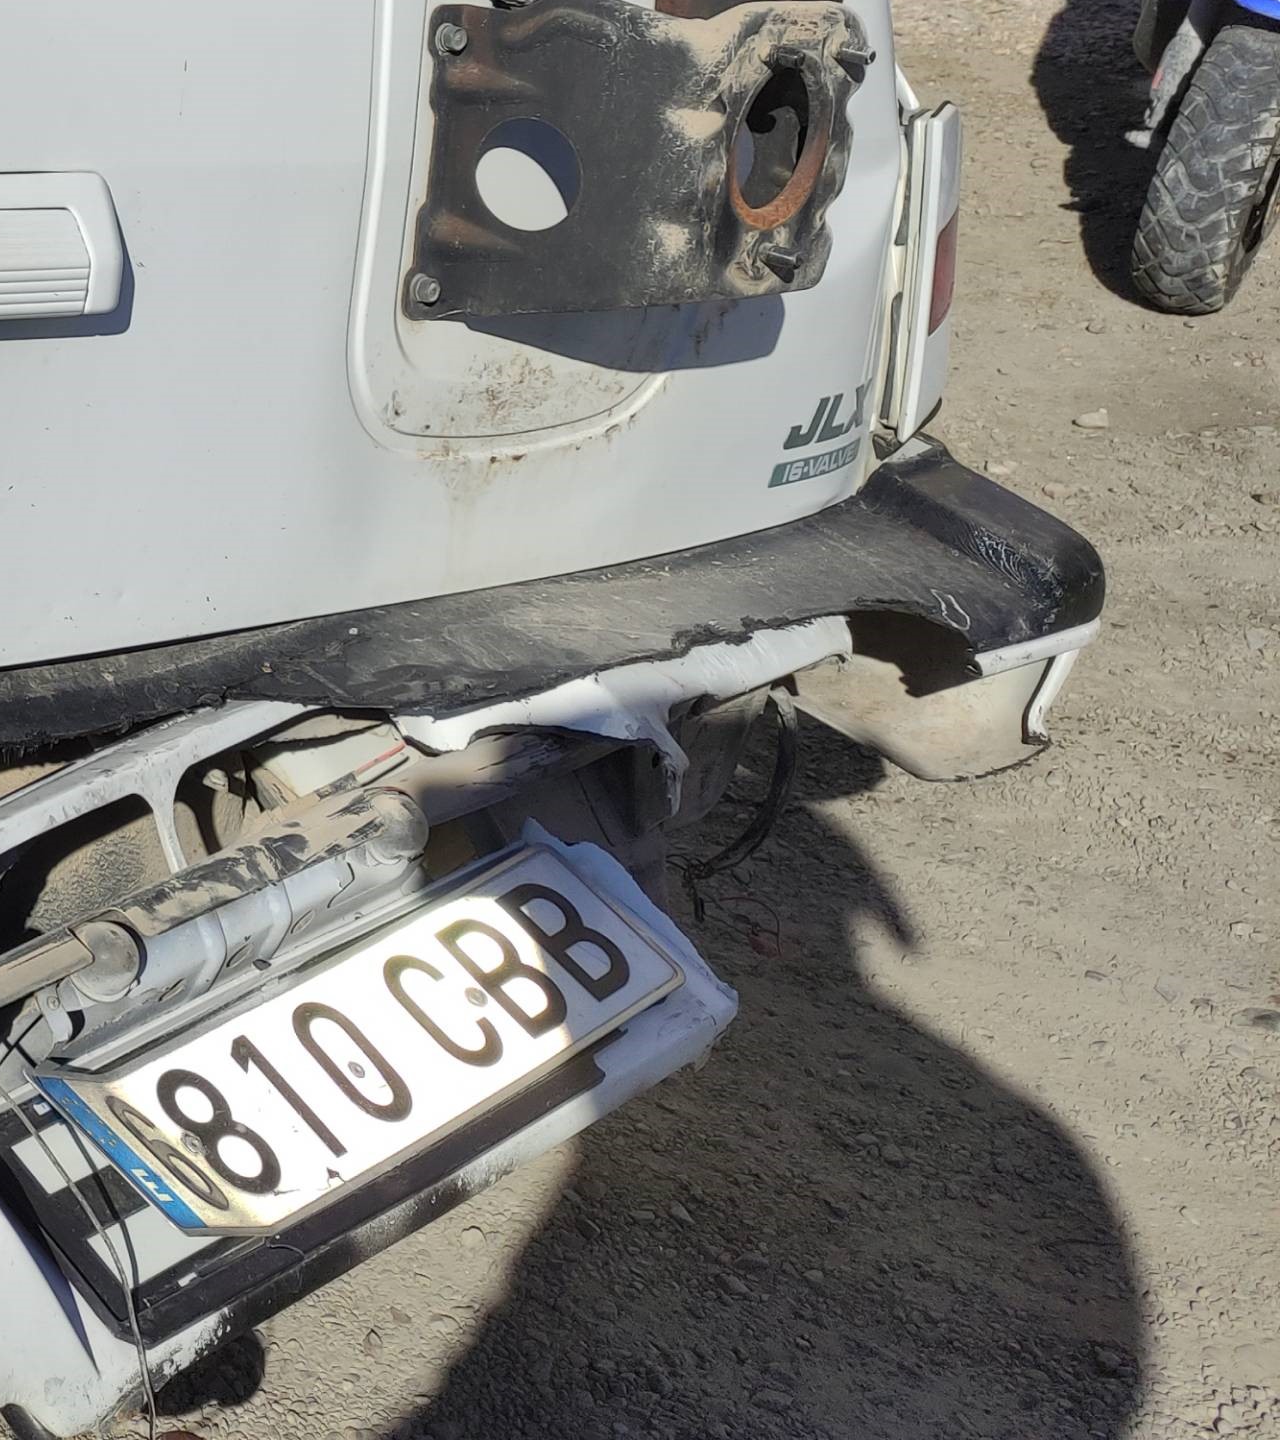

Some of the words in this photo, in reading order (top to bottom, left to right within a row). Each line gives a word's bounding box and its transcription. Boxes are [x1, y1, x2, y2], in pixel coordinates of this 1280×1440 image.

[783, 377, 873, 450] JLX
[103, 1001, 415, 1212] 6810
[382, 881, 633, 1068] CBB
[130, 1167, 175, 1204] E
